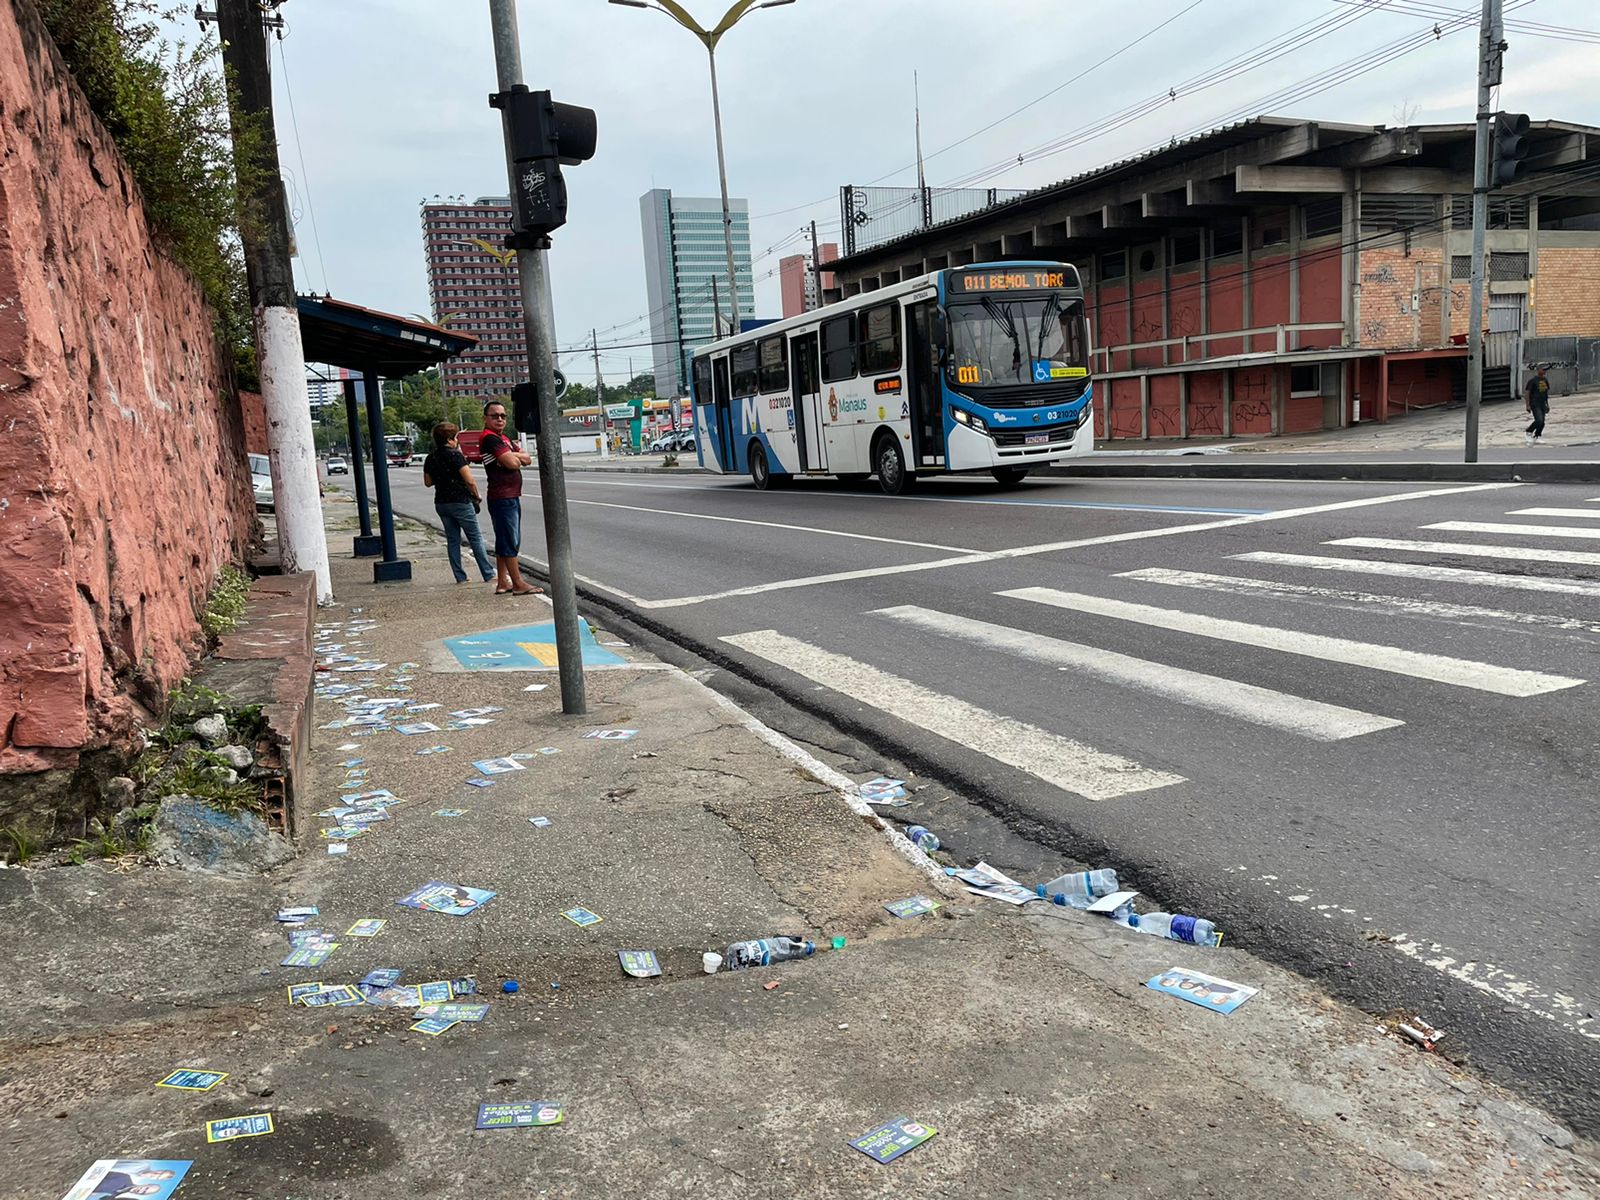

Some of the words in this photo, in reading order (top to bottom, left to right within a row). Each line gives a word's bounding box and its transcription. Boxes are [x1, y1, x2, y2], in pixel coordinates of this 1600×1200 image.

[964, 275, 986, 290] 011
[989, 274, 1031, 289] BEMOL
[958, 366, 979, 384] 011
[769, 396, 791, 410] 0321020
[838, 397, 867, 413] Manaus
[1047, 408, 1078, 421] 0321020
